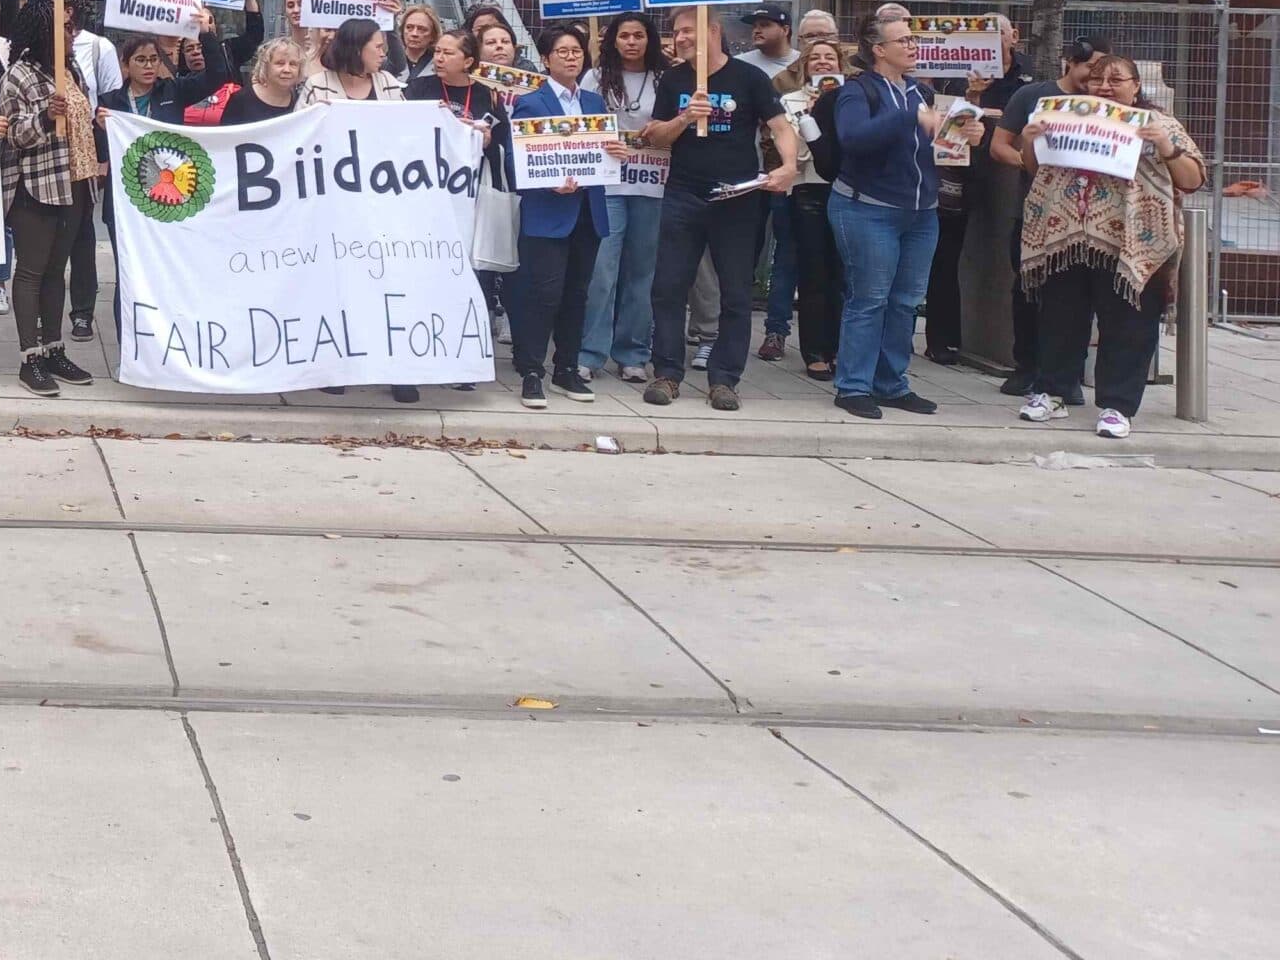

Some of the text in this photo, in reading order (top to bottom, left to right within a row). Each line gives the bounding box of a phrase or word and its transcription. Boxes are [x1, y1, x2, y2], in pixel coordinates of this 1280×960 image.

[311, 0, 377, 17] Wellness!
[917, 36, 946, 44] ime for
[928, 62, 972, 70] Beginning
[680, 94, 731, 108] DRE
[1046, 121, 1135, 145] upport Worker
[525, 143, 561, 153] Support
[563, 141, 598, 150] Workers
[527, 151, 602, 166] Anishnawbe
[621, 154, 669, 167] nd Livea
[528, 166, 596, 178] Health Toronto
[230, 232, 464, 279] a new beginning
[133, 293, 494, 369] FAIR DEAL FOR AL
